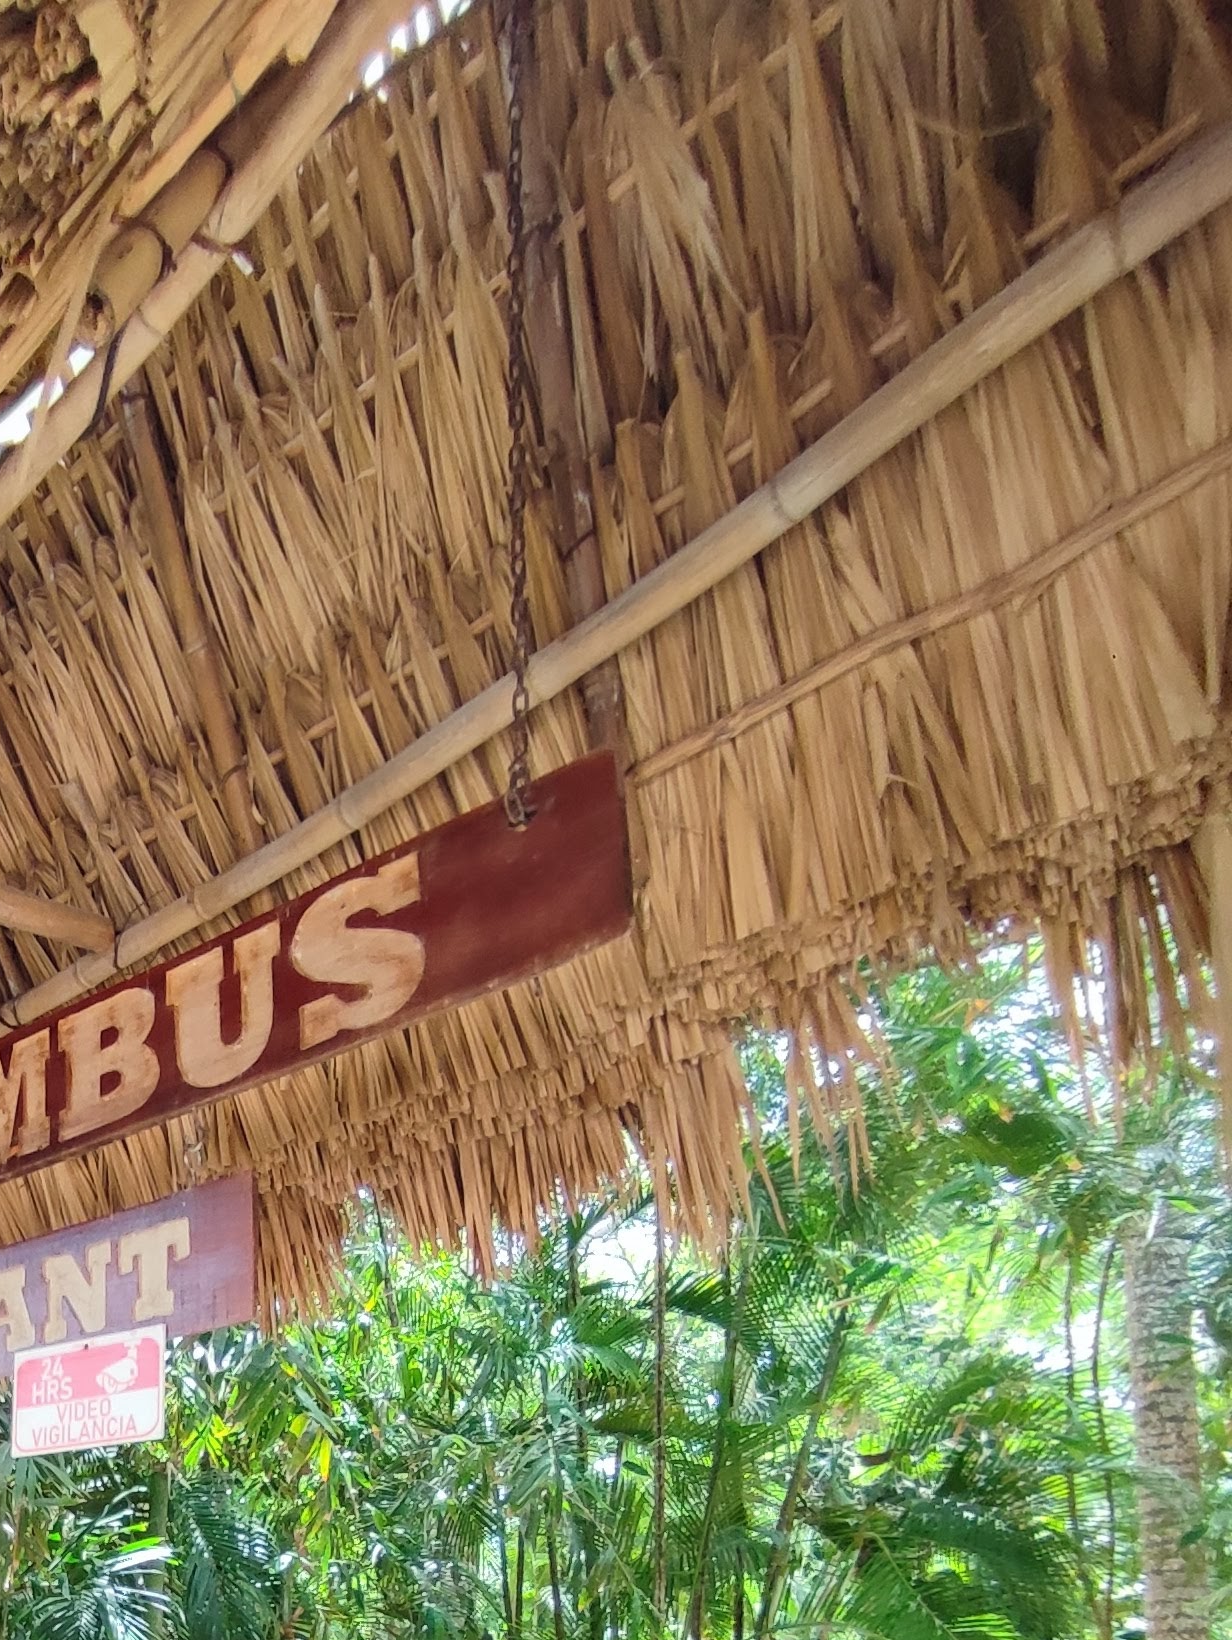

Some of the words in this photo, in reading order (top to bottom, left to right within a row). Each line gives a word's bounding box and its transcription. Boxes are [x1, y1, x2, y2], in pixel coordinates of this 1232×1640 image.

[41, 1357, 65, 1380] 24
[31, 1376, 73, 1404] HRS
[56, 1397, 111, 1424] VIDEO
[31, 1413, 138, 1447] VIGILANCIA
